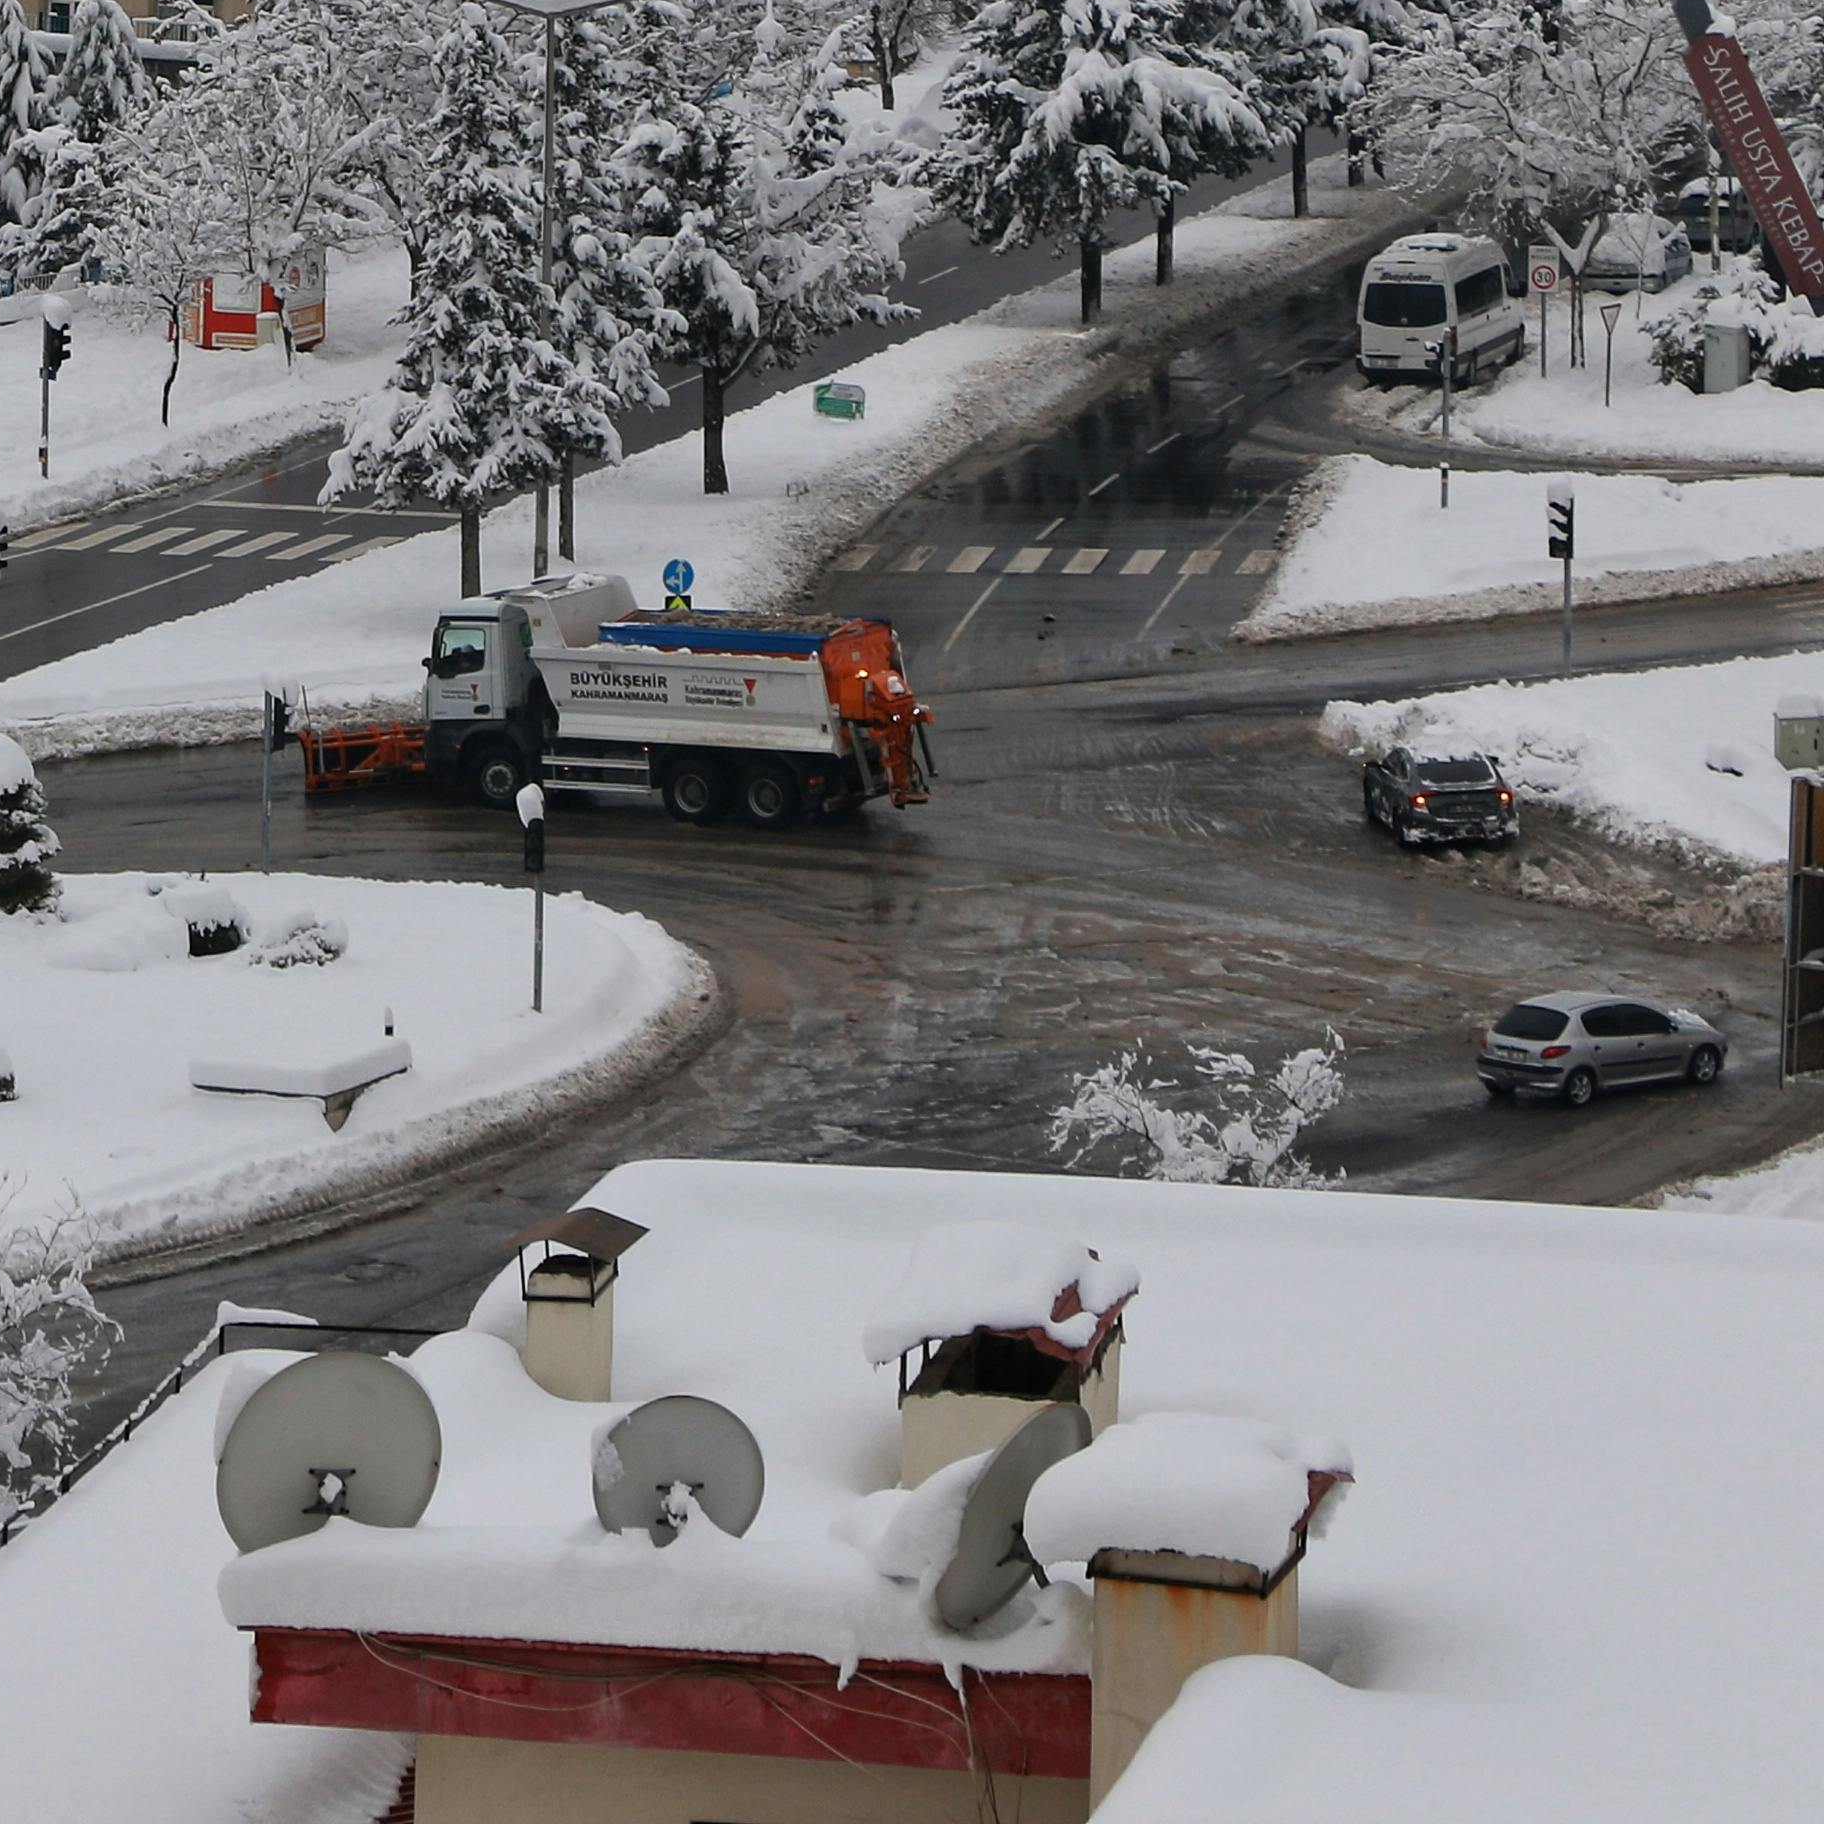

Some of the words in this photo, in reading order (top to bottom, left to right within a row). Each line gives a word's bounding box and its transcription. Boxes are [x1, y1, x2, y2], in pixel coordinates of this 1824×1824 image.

[1741, 126, 1782, 194] USTA
[1772, 194, 1824, 285] KEBAP
[1536, 271, 1552, 284] 30
[570, 670, 668, 689] BÜYÜKŞEHİR
[570, 688, 669, 704] KAHRAMANMARAŞ
